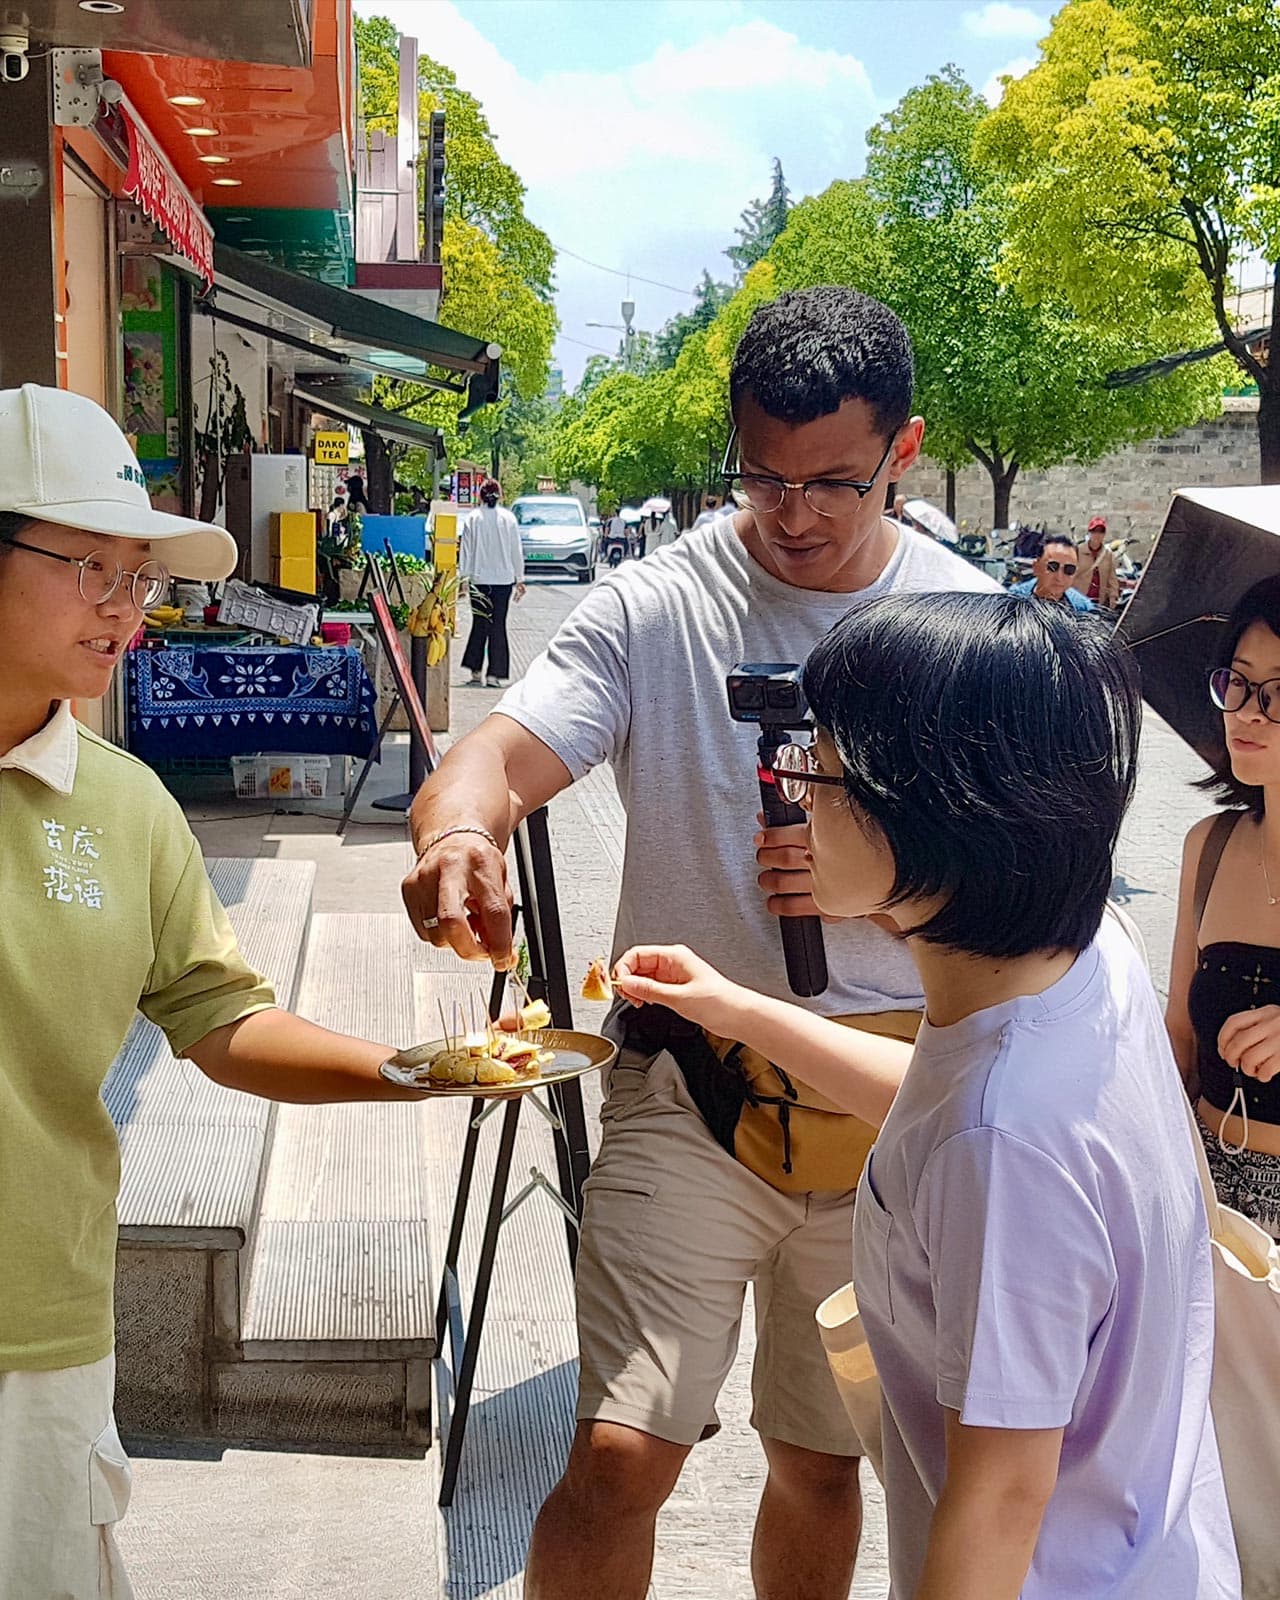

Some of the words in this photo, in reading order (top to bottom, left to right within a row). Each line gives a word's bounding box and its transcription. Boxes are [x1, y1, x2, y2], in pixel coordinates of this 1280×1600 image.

[318, 440, 346, 449] DAKO
[322, 451, 341, 459] TEA
[42, 818, 100, 859] 吉庆
[43, 866, 104, 909] 花语
